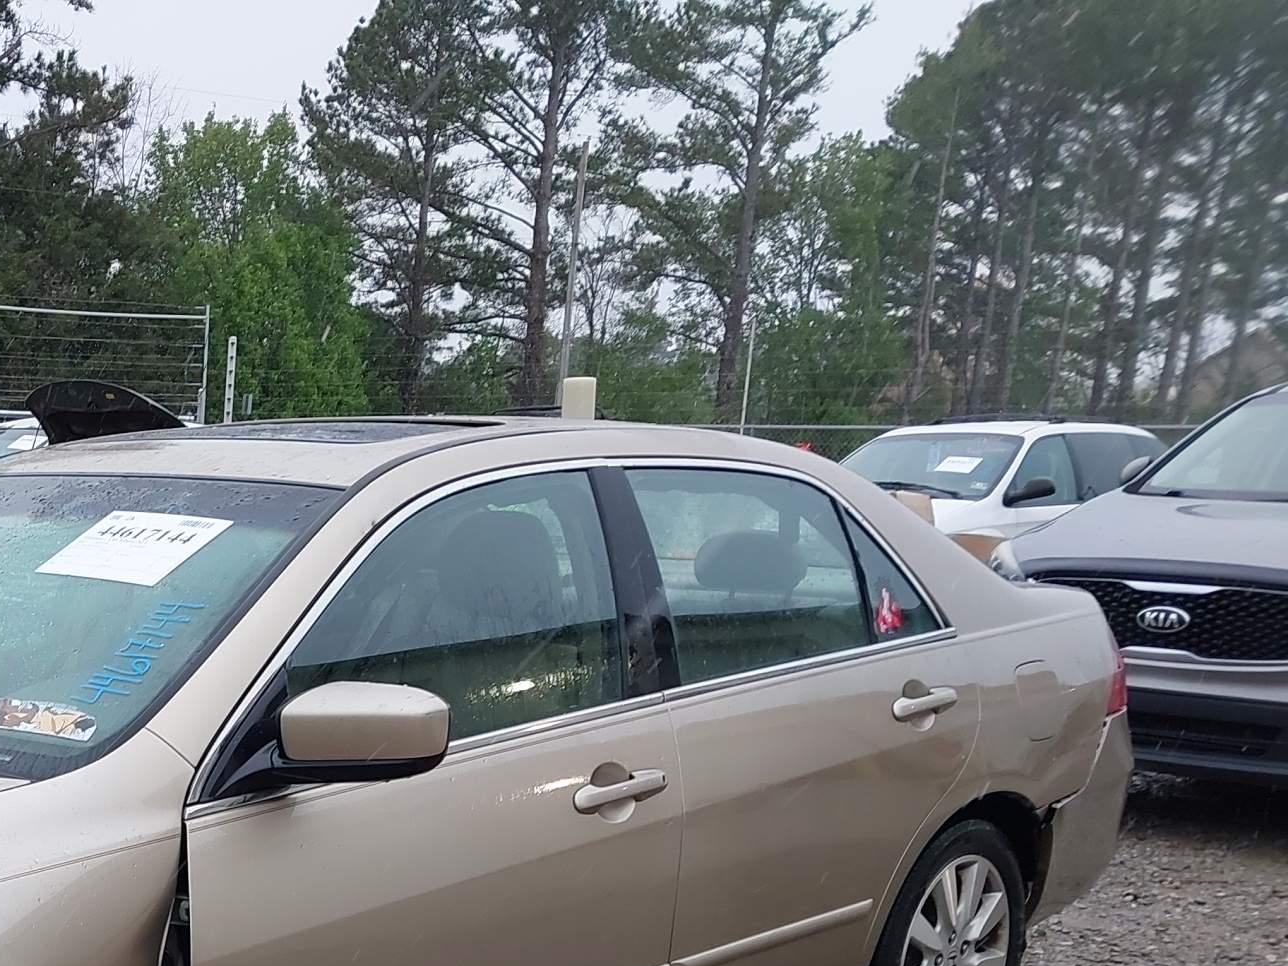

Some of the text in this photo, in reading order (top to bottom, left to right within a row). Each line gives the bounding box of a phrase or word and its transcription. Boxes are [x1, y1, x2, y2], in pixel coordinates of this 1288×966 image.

[97, 525, 198, 545] 44617144
[1143, 611, 1180, 628] KIA
[70, 600, 206, 705] 44617144
